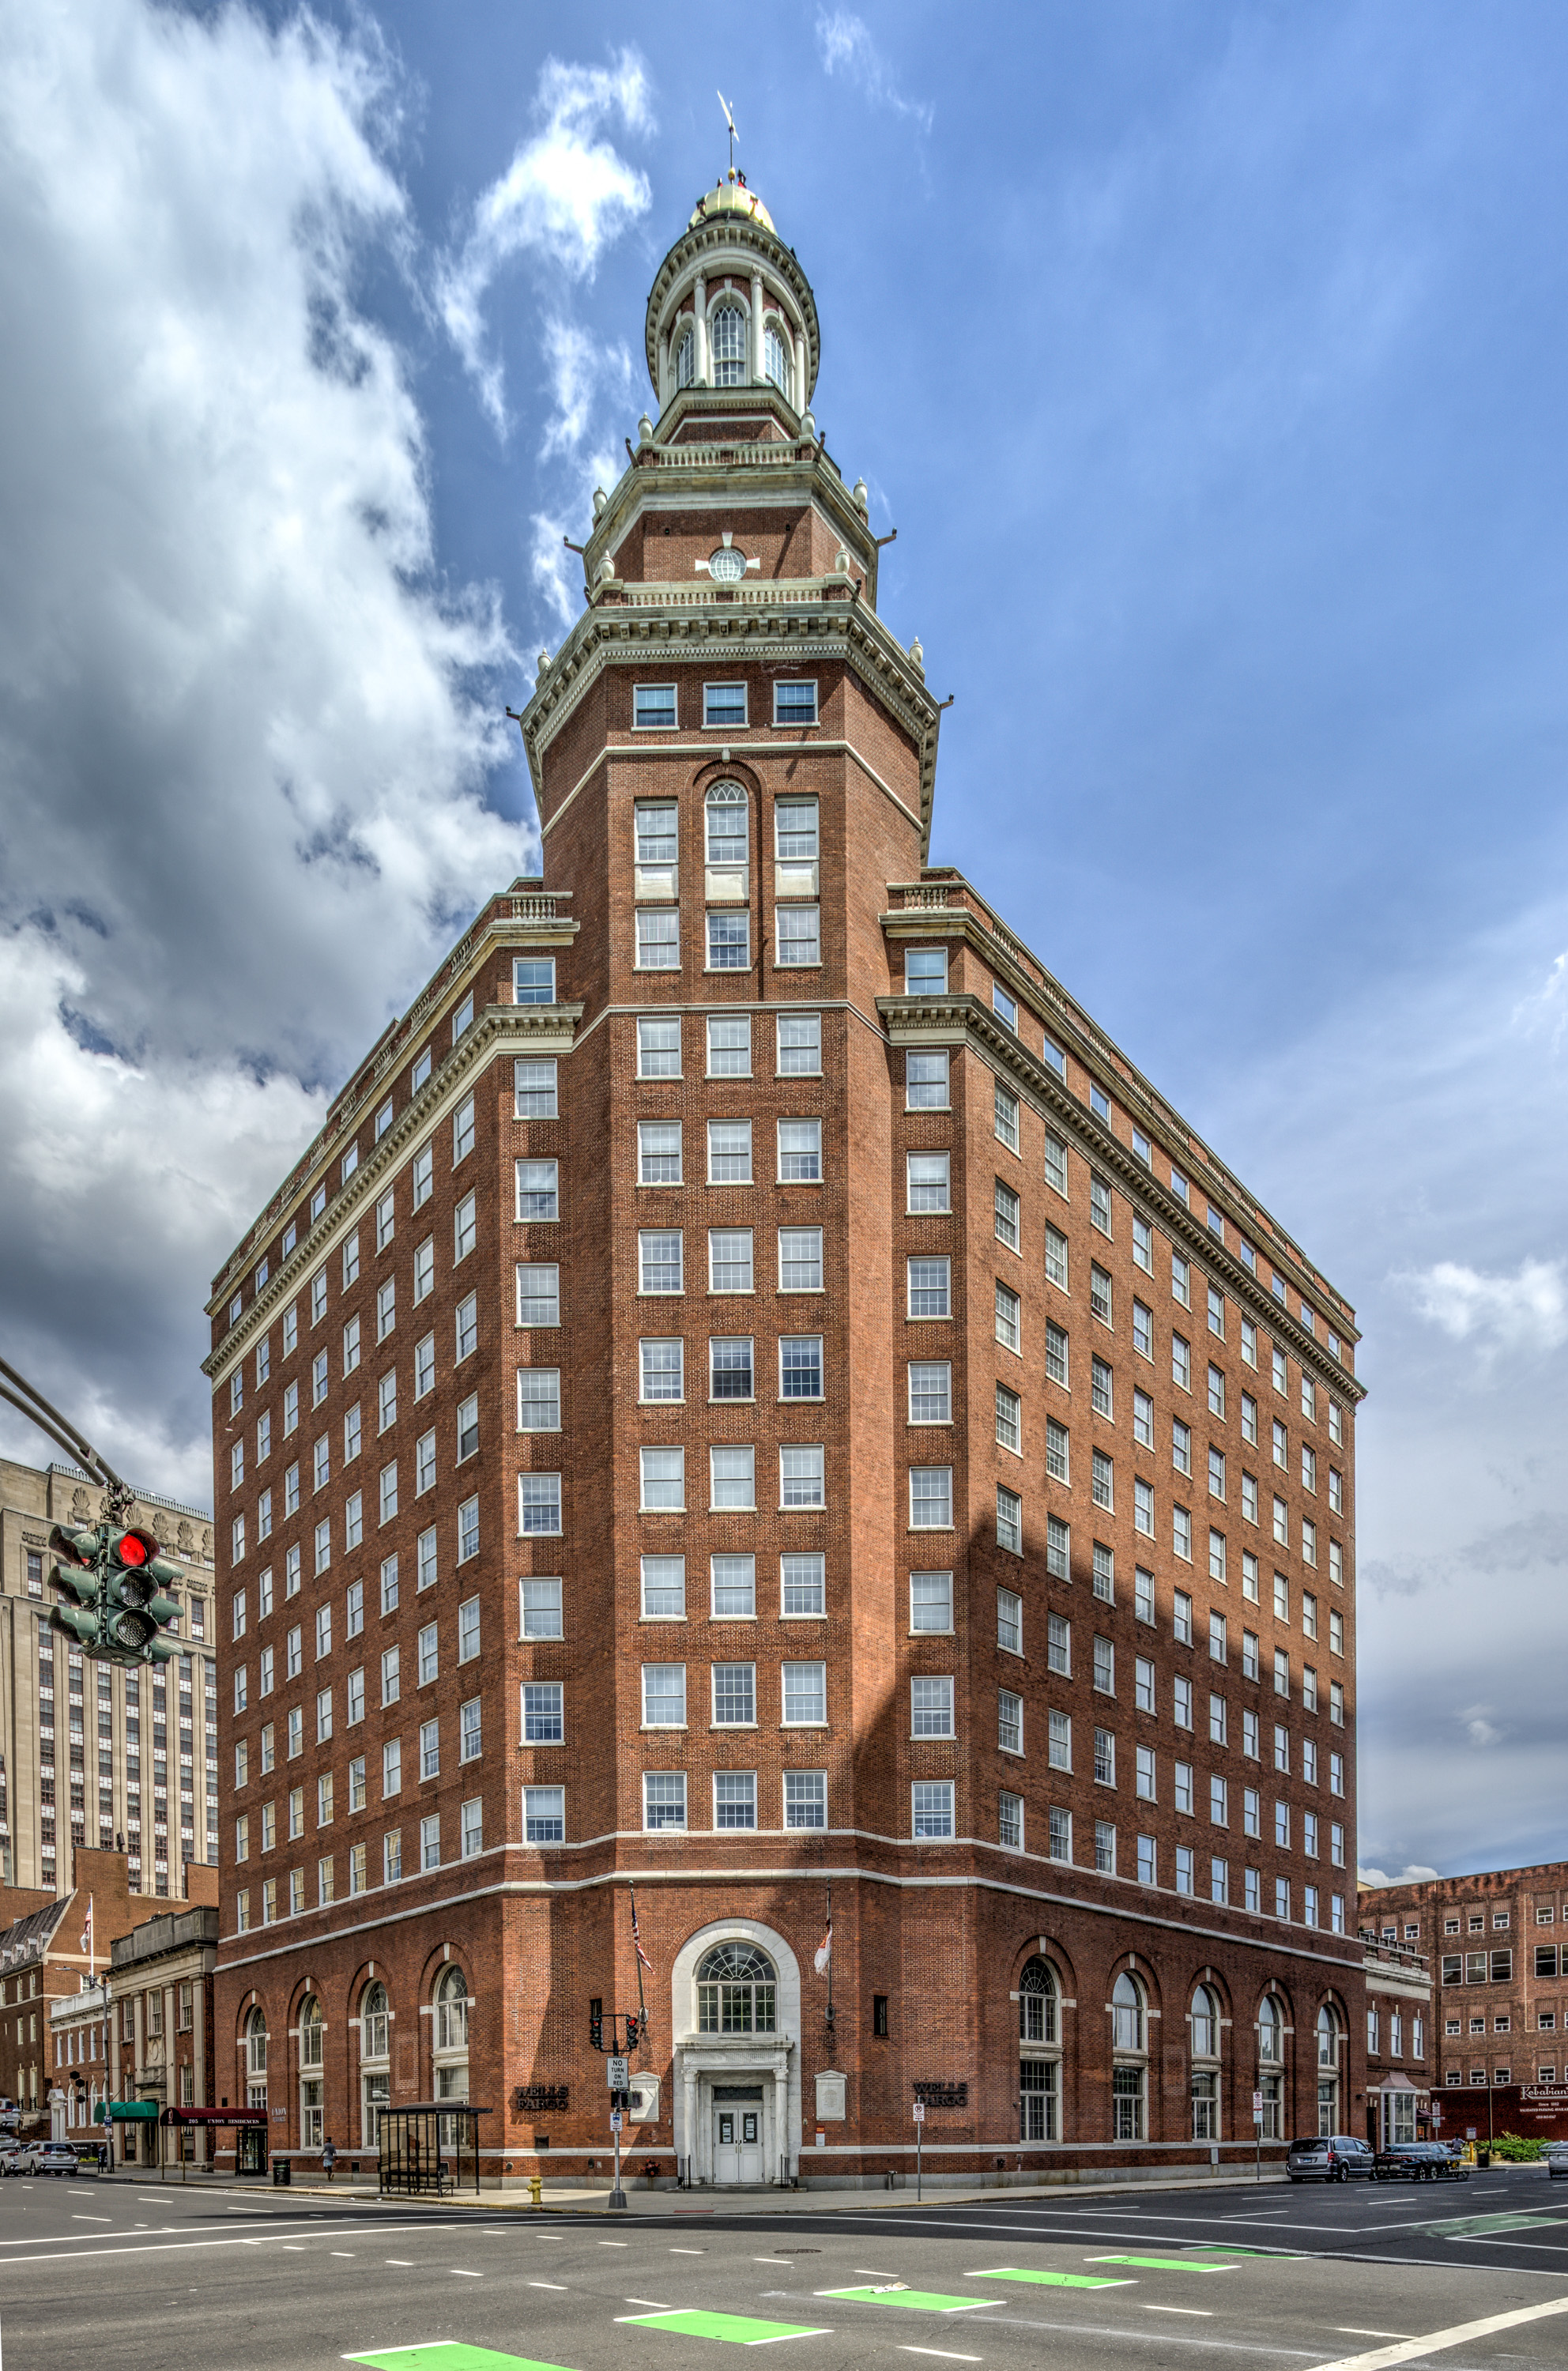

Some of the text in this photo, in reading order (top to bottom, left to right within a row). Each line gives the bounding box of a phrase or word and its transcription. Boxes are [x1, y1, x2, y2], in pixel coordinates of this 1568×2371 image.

[514, 2086, 568, 2097] WELLS
[914, 2082, 968, 2094] WELLS
[516, 2098, 568, 2109] FARGO
